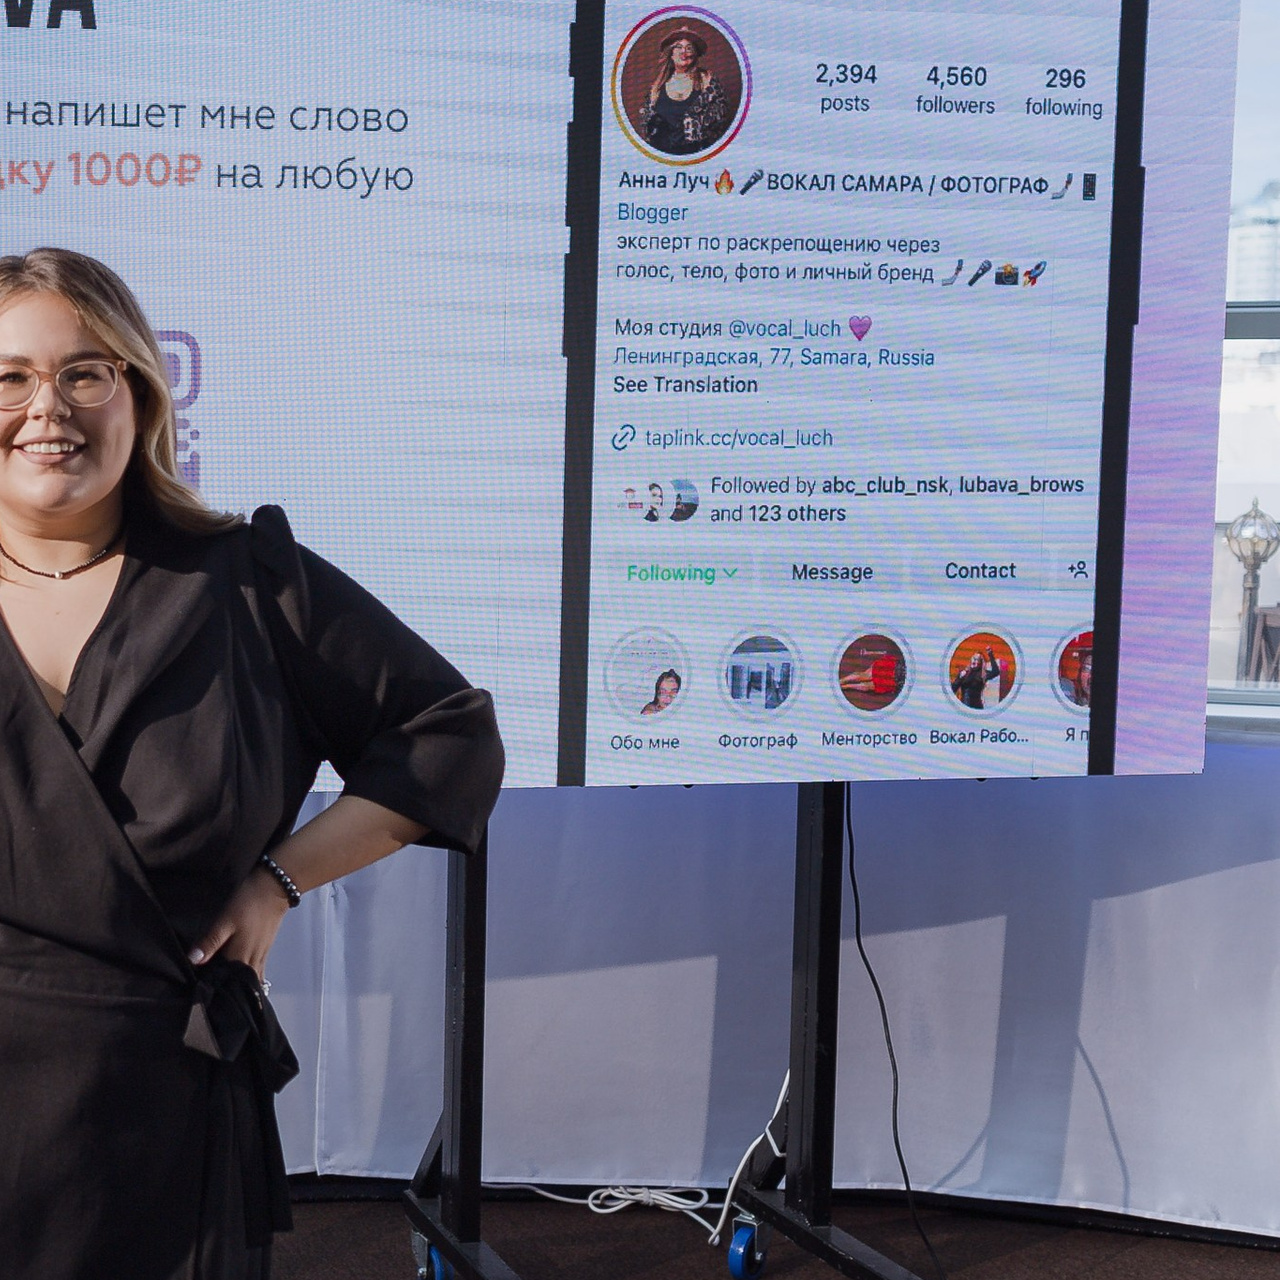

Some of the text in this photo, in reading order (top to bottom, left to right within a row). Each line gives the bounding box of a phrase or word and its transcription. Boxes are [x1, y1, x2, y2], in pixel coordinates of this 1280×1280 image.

[816, 64, 878, 87] 2,394
[926, 66, 987, 88] 4,560
[1046, 69, 1086, 89] 296
[820, 94, 870, 115] posts
[916, 95, 996, 114] followers
[1026, 98, 1103, 120] following
[5, 98, 187, 132] напишет
[199, 102, 277, 132] мне
[290, 102, 409, 136] слово
[67, 154, 204, 188] 1000₽
[215, 159, 263, 189] на
[276, 158, 414, 198] любую
[619, 173, 667, 190] Анна
[672, 173, 709, 192] Луч
[768, 174, 835, 192] ВОКАЛ
[841, 174, 923, 193] САМАРА
[940, 176, 1048, 195] ФОТОГРАФ
[618, 204, 688, 224] Blogger
[616, 235, 940, 255] эксперт по раскрепощению через
[616, 262, 934, 284] голос, тело, фото и личный бренд
[615, 320, 841, 339] Моя студия @vocal_luch
[614, 349, 934, 368] Ленинградская, 77, Samara, Russia
[614, 376, 758, 393] See Translation
[646, 429, 833, 449] taplink.cc/vocal_luch
[712, 476, 1084, 497] Followed by abc_club_nsk, lubava_brows
[710, 504, 846, 522] and 123 others
[627, 564, 716, 585] Following
[792, 563, 873, 582] Message
[945, 562, 1016, 580] Contact
[610, 734, 680, 751] Обо мне
[719, 731, 798, 751] Фотограф
[822, 730, 917, 748] Менторство
[930, 729, 976, 745] Вокал
[1066, 728, 1076, 742] Я
